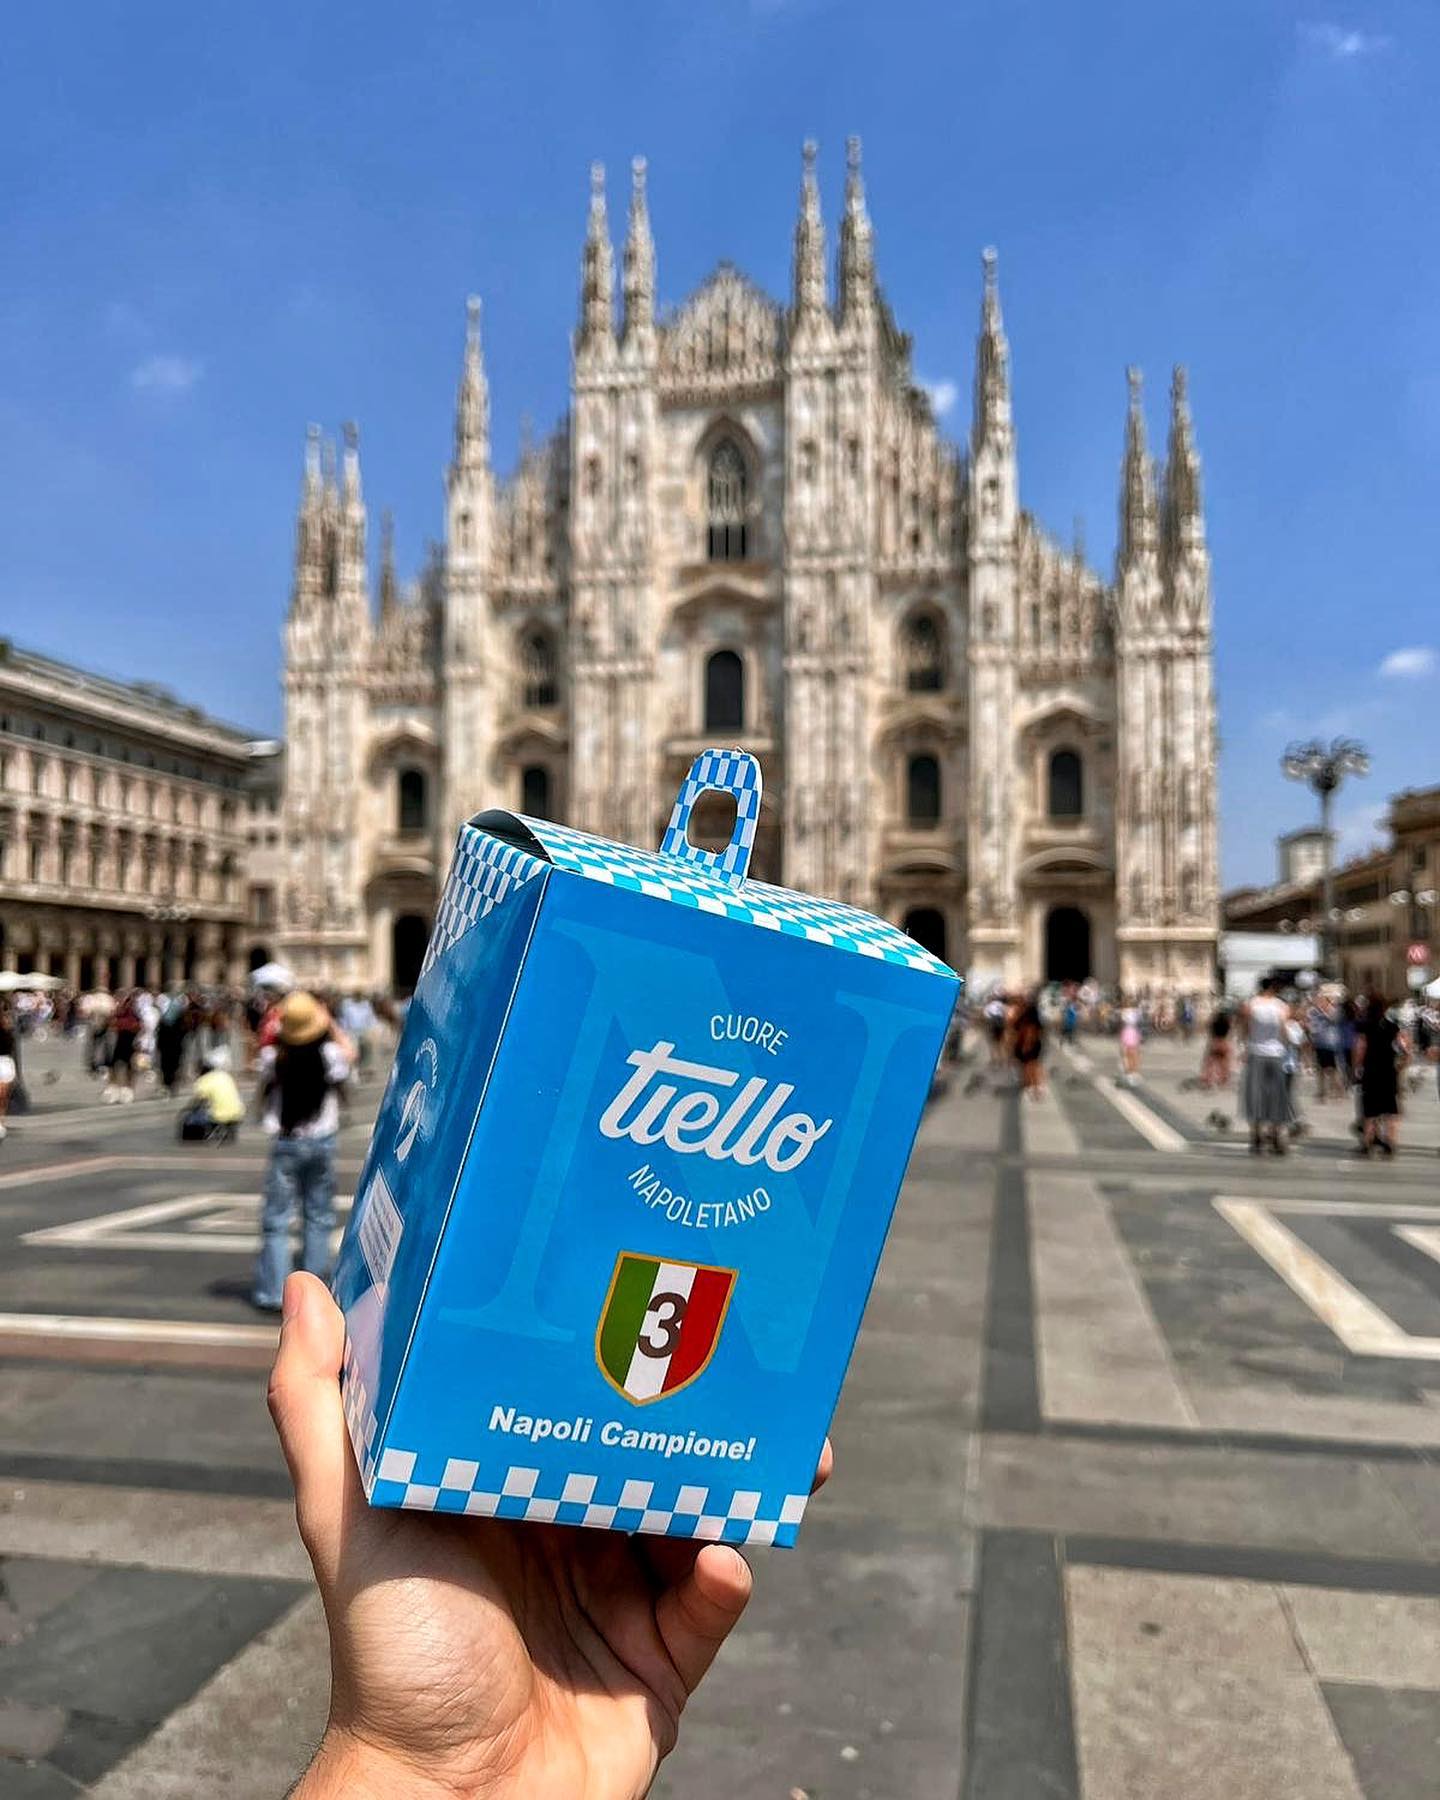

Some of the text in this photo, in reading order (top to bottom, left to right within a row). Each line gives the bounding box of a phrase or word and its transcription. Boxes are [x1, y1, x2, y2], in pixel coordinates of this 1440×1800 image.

[710, 1014, 789, 1056] CUORE
[600, 1040, 833, 1172] tiello
[628, 1164, 771, 1228] NAPOLETANO
[637, 1292, 688, 1358] 3
[488, 1405, 757, 1460] Napoli Campione!
